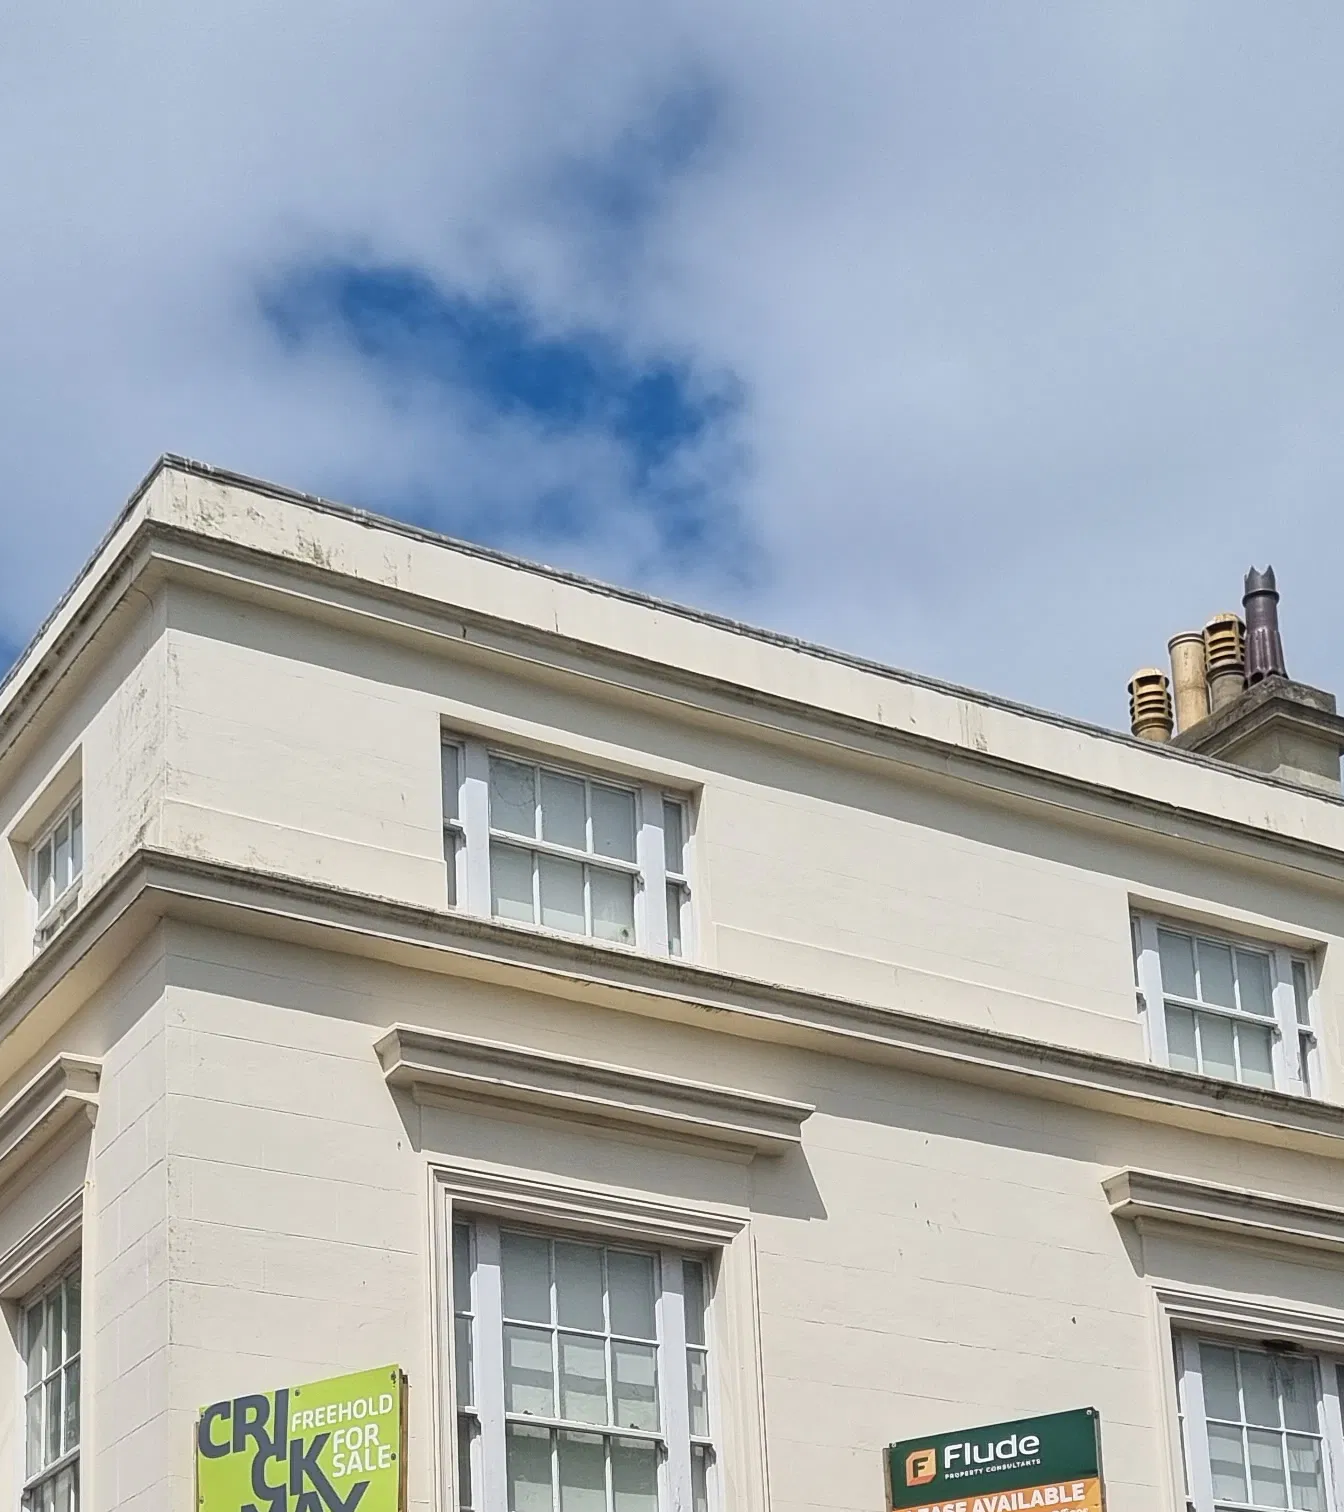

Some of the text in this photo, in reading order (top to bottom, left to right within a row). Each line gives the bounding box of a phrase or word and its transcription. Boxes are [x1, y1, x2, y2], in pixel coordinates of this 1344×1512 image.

[291, 1394, 393, 1432] FREEHOLD
[332, 1424, 379, 1453] FOR
[944, 1434, 1040, 1469] Flude
[332, 1445, 391, 1478] SALE
[945, 1458, 1041, 1480] PROPERTY CONSULTANTS
